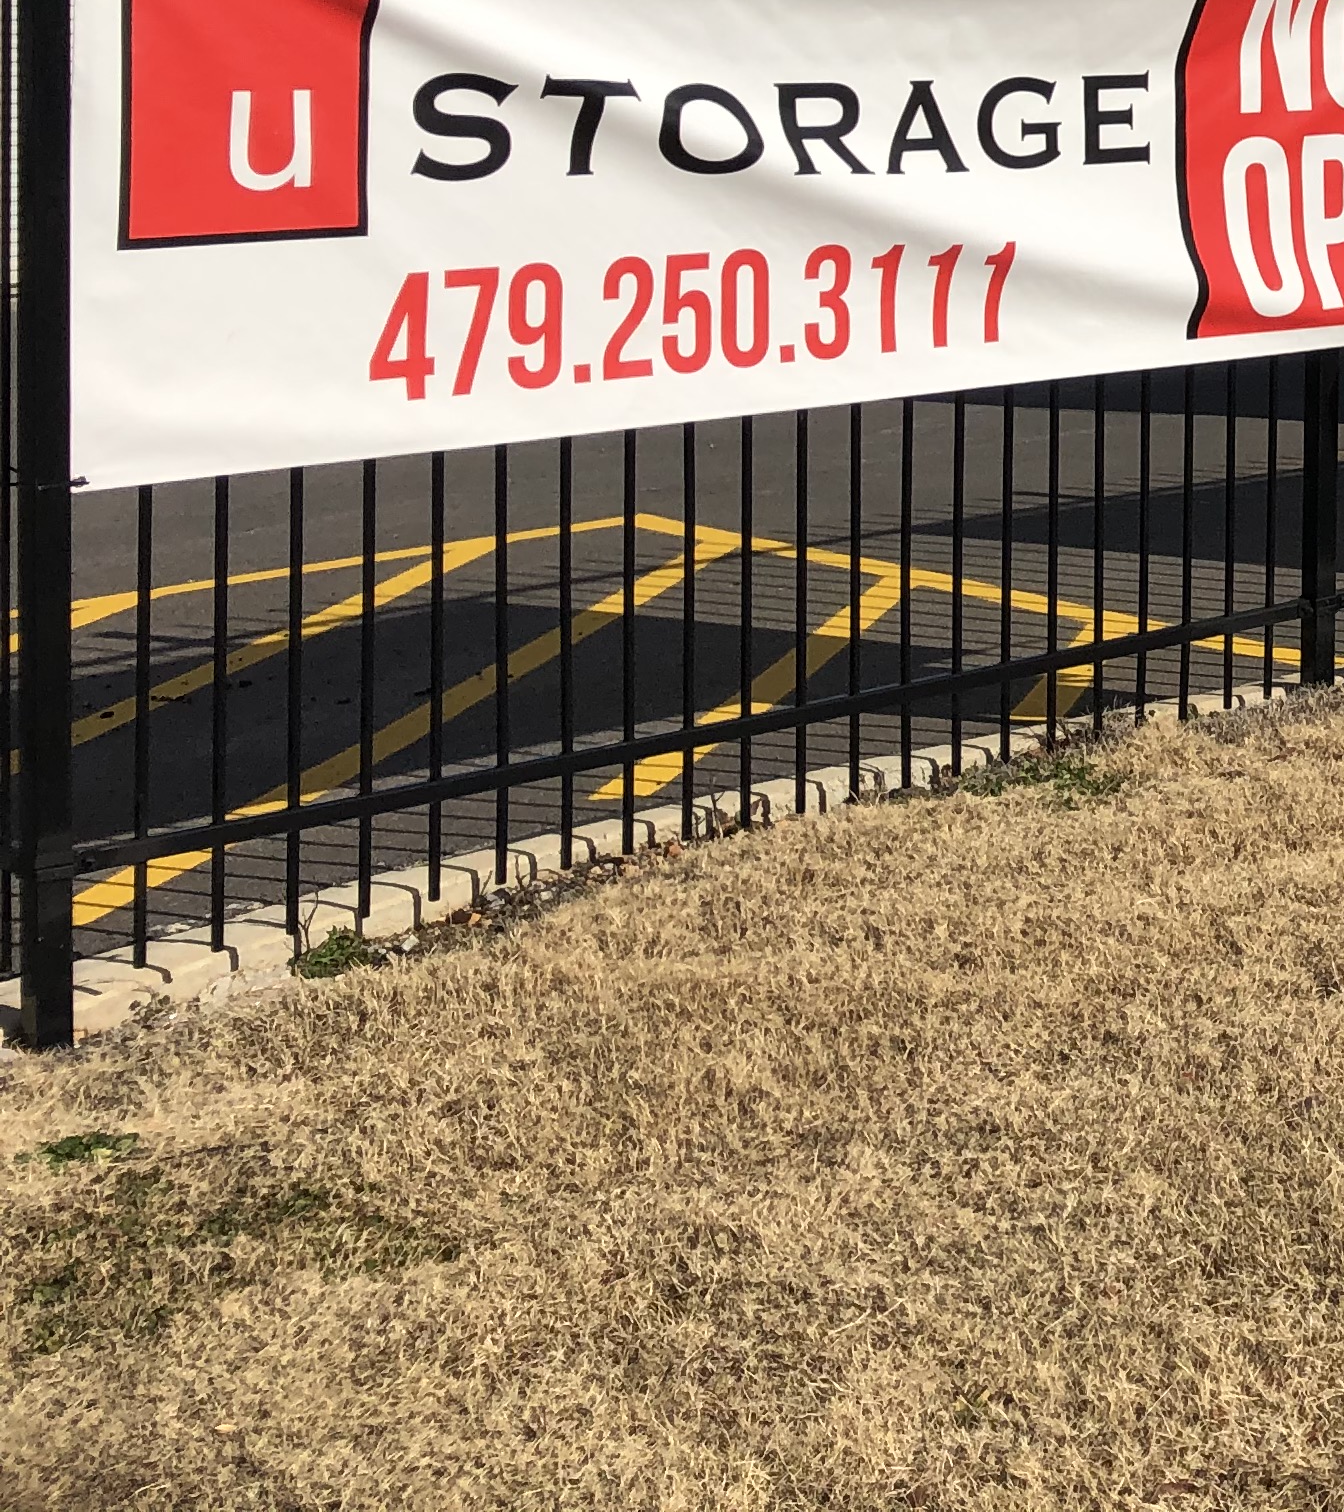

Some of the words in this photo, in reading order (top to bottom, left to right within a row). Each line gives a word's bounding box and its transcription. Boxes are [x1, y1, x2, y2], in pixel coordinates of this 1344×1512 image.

[230, 89, 312, 192] u
[411, 70, 1151, 182] STORAGE
[369, 241, 1017, 402] 479.250.3111
